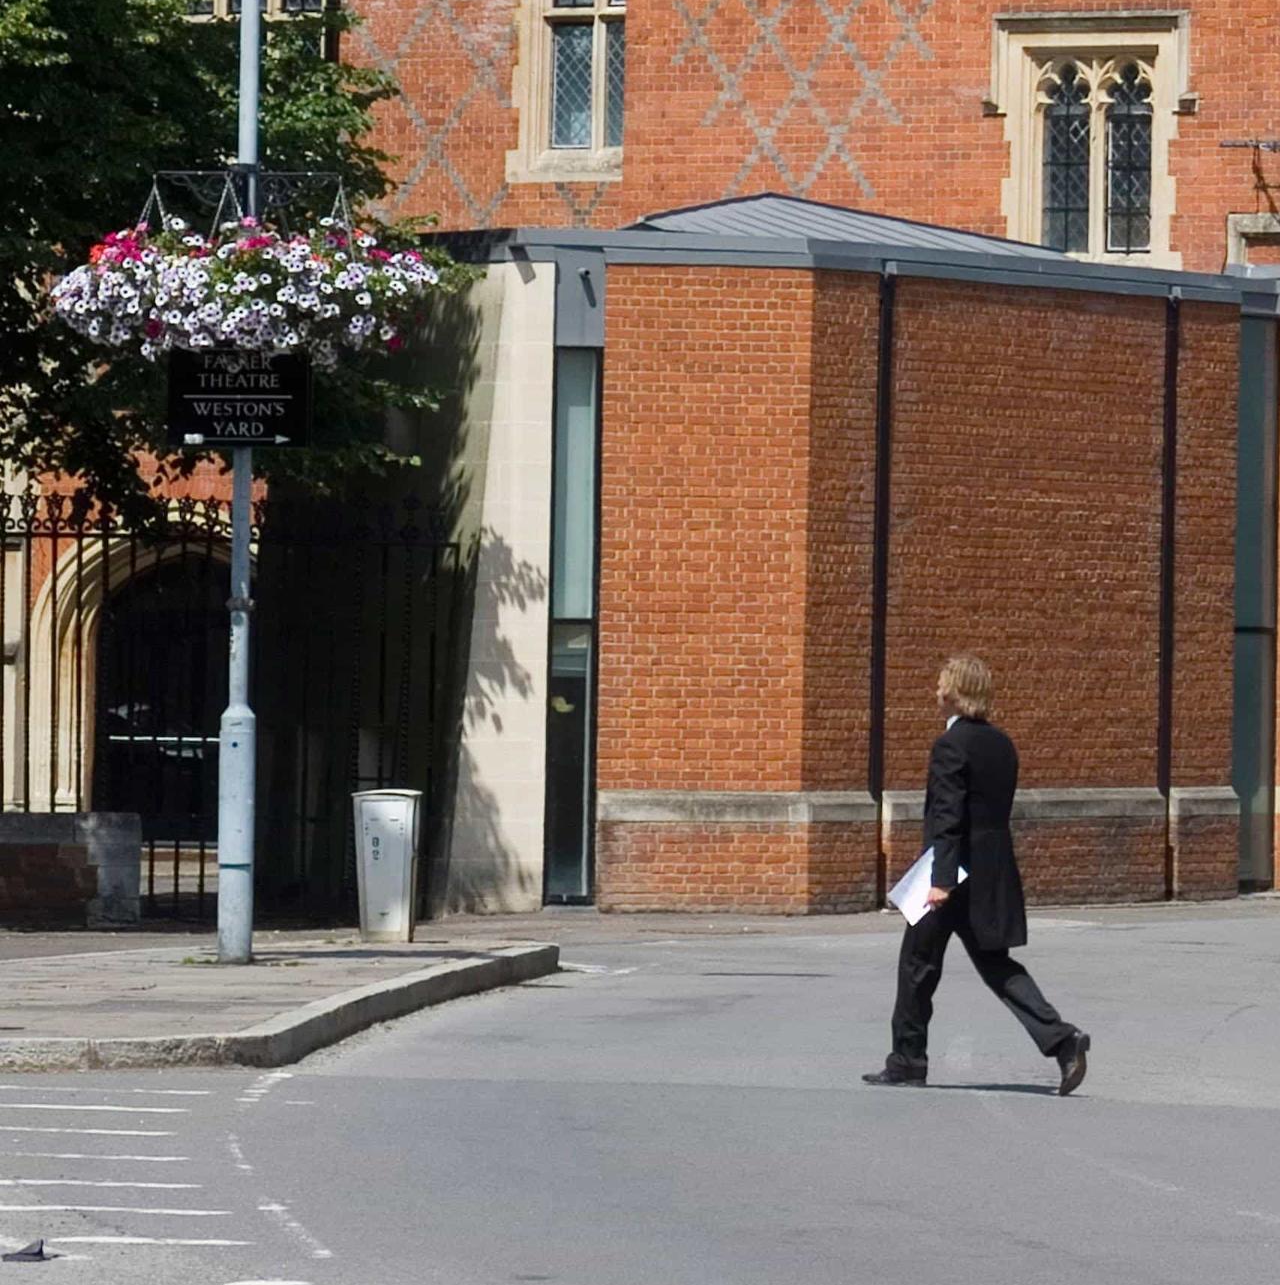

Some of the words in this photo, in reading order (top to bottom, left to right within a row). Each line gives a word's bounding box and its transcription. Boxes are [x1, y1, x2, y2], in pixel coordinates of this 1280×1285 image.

[196, 373, 281, 389] THEATRE
[192, 401, 286, 417] WESTON'S
[212, 421, 264, 437] YARD
